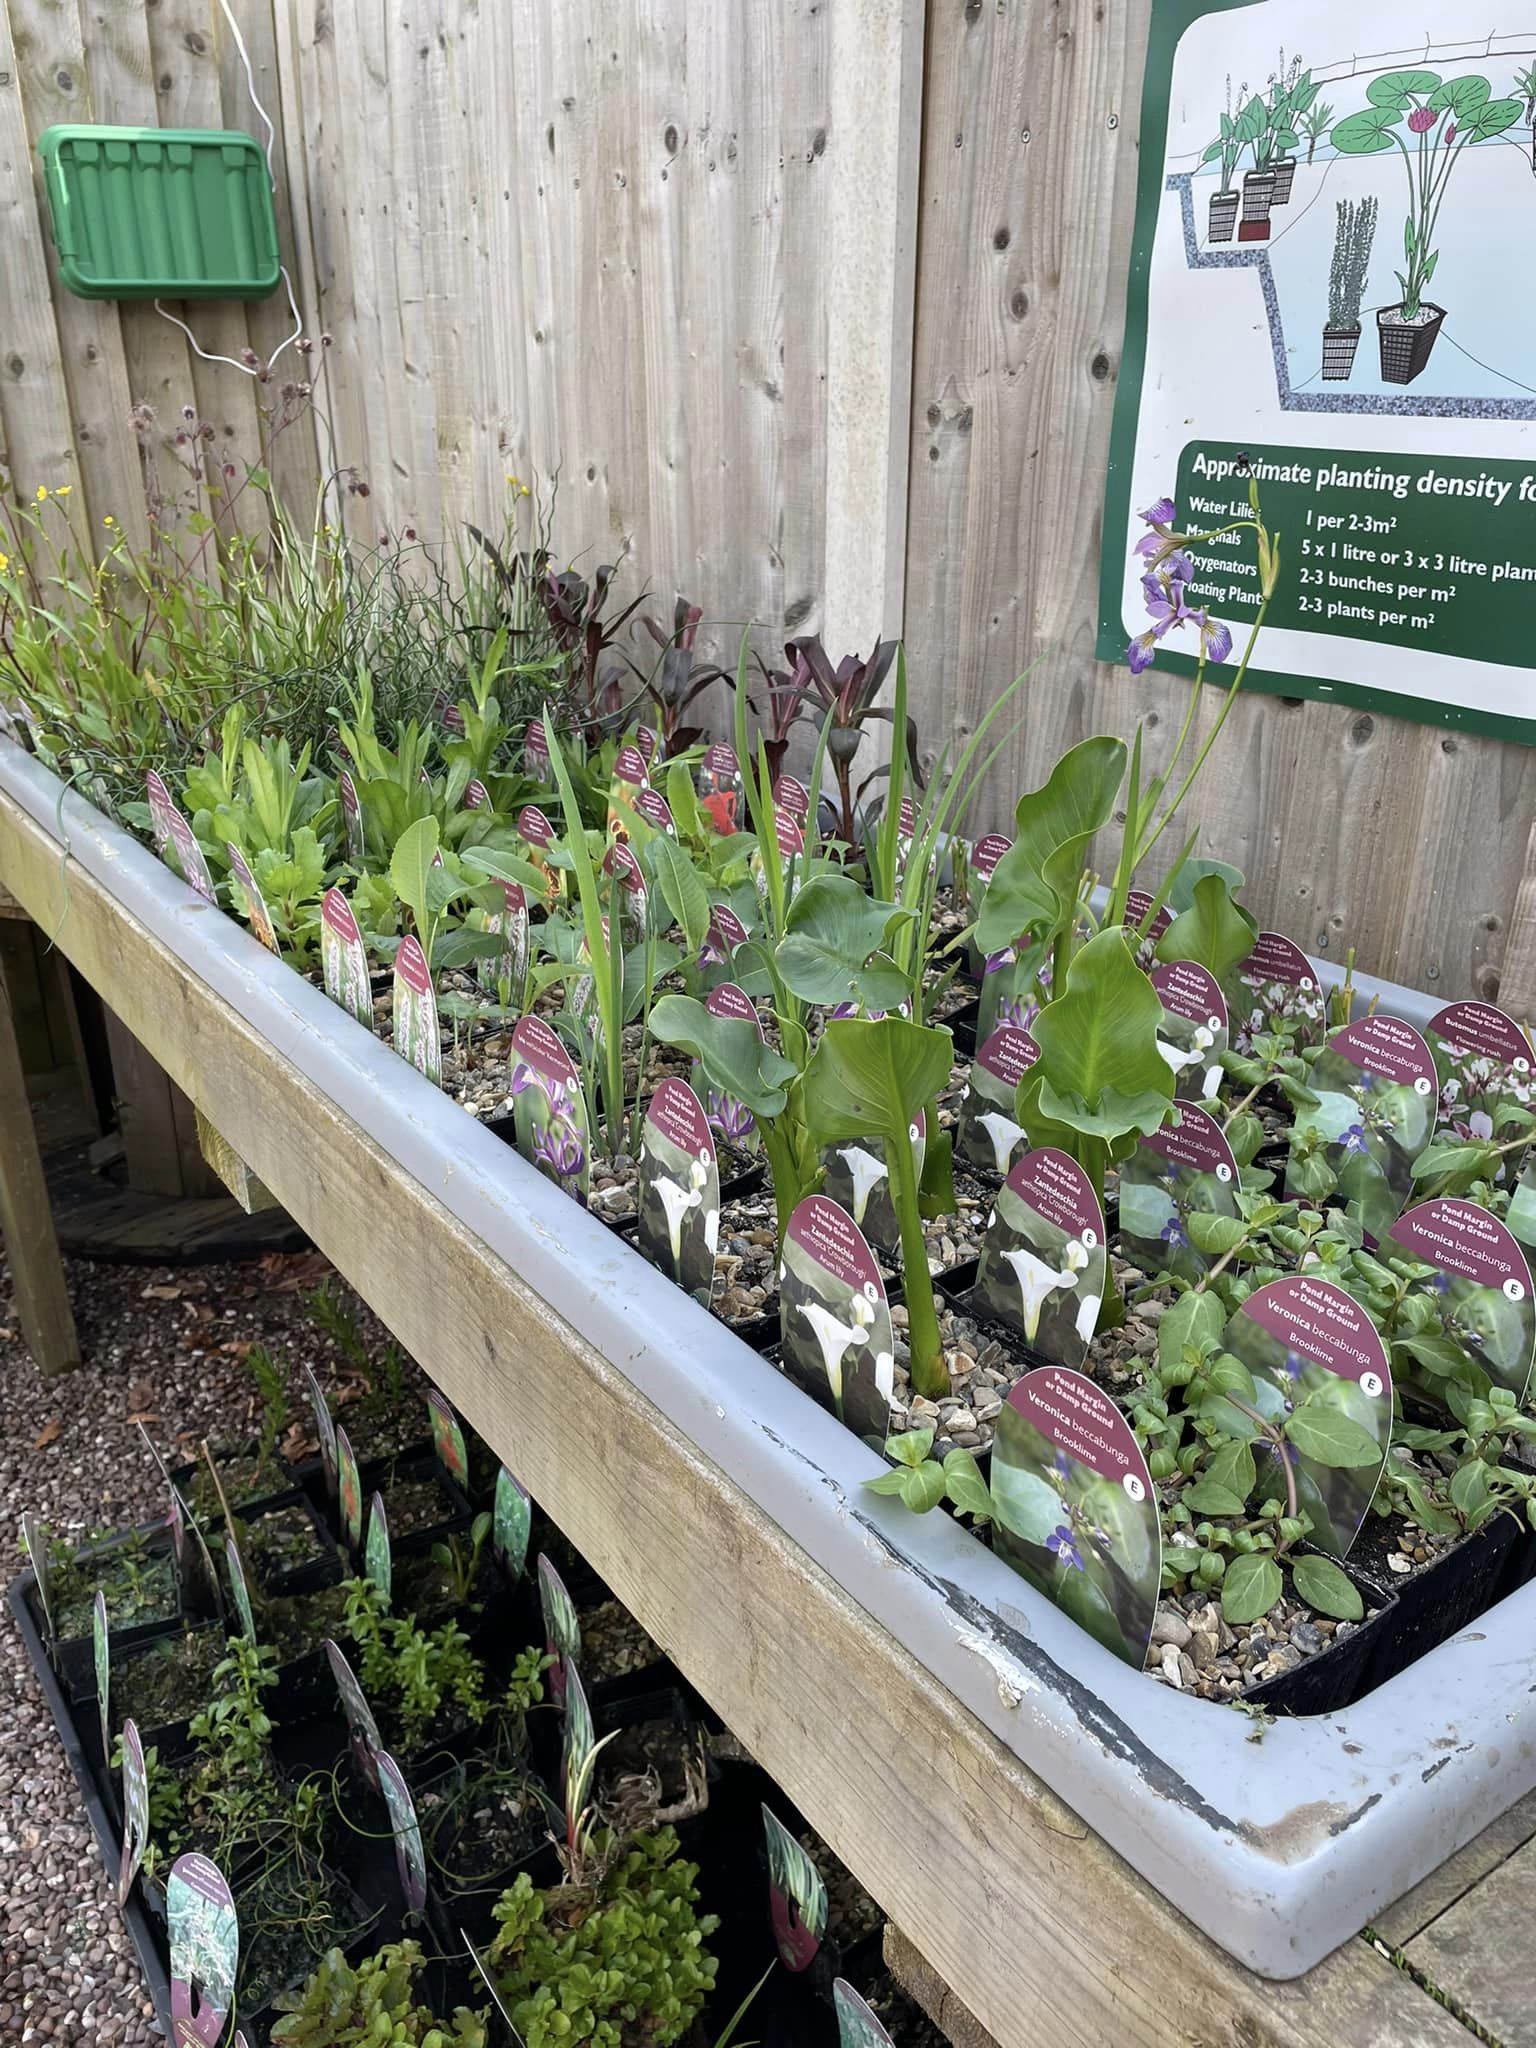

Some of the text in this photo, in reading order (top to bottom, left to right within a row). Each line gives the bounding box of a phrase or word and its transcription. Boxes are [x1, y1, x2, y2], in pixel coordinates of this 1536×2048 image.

[1316, 464, 1411, 498] planting
[1417, 470, 1512, 506] density
[1189, 496, 1261, 519] Water Lilie
[1317, 515, 1345, 531] per
[1184, 550, 1257, 576] Oxygenators
[1301, 539, 1311, 555] 5
[1315, 544, 1325, 557] x
[1343, 544, 1376, 562] litre
[1381, 552, 1400, 565] or
[1404, 551, 1413, 567] 3
[1418, 556, 1429, 569] x
[1434, 554, 1444, 570] 3
[1450, 556, 1487, 576] litre
[1492, 561, 1536, 582] plan
[1228, 586, 1264, 606] Plant
[1300, 568, 1324, 584] 2-3
[1328, 571, 1394, 594] bunches
[1398, 583, 1427, 600] per
[1298, 596, 1322, 612] 2-3
[1327, 600, 1375, 618] plants
[1379, 610, 1407, 626] per
[1175, 966, 1205, 984] Pond Margin
[1189, 980, 1209, 993] Ground
[1463, 1005, 1503, 1025] Pond Margin
[1464, 1013, 1483, 1025] Damp
[1483, 1020, 1509, 1034] Ground
[1372, 1029, 1391, 1042] Damp
[1391, 1036, 1416, 1051] Ground
[1373, 1019, 1413, 1041] Pond Margin
[1445, 1017, 1518, 1051] Butomus umbellatus
[1348, 1034, 1423, 1073] Veronica beccabunga
[1455, 1035, 1502, 1059] Flowering rush
[1363, 1056, 1396, 1076] Brooklime
[1183, 1110, 1205, 1124] Margin
[1186, 1121, 1210, 1135] Ground
[1166, 1144, 1198, 1163] Brooklime
[1179, 1136, 1221, 1159] beccabunga
[1042, 1165, 1059, 1182] Damp
[1059, 1176, 1082, 1195] Ground
[1043, 1155, 1078, 1183] Pond Margin
[1034, 1175, 1078, 1210] Zantedeschia
[1037, 1202, 1054, 1218] Arum
[1441, 1203, 1493, 1231] Pond Margin
[829, 1214, 850, 1233] Margin
[833, 1226, 855, 1247] Ground
[1431, 1211, 1499, 1244] or Damp Ground
[811, 1224, 855, 1262] Zantedeschia
[1411, 1221, 1512, 1273] Veronica beccabunga
[1434, 1249, 1478, 1276] Brooklime
[1300, 1281, 1354, 1317] Pond Margin
[1510, 1284, 1518, 1295] E
[1289, 1289, 1360, 1332] or Damp Ground
[1267, 1298, 1371, 1366] Veronica beccabunga
[1289, 1331, 1334, 1365] Brooklime
[1054, 1371, 1107, 1412] Pond Margin
[1367, 1378, 1376, 1390] E
[1045, 1380, 1114, 1429] or Damp Ground
[1028, 1389, 1129, 1466] Veronica beccabunga
[1053, 1426, 1097, 1464] Brooklime
[1130, 1481, 1139, 1494] E
